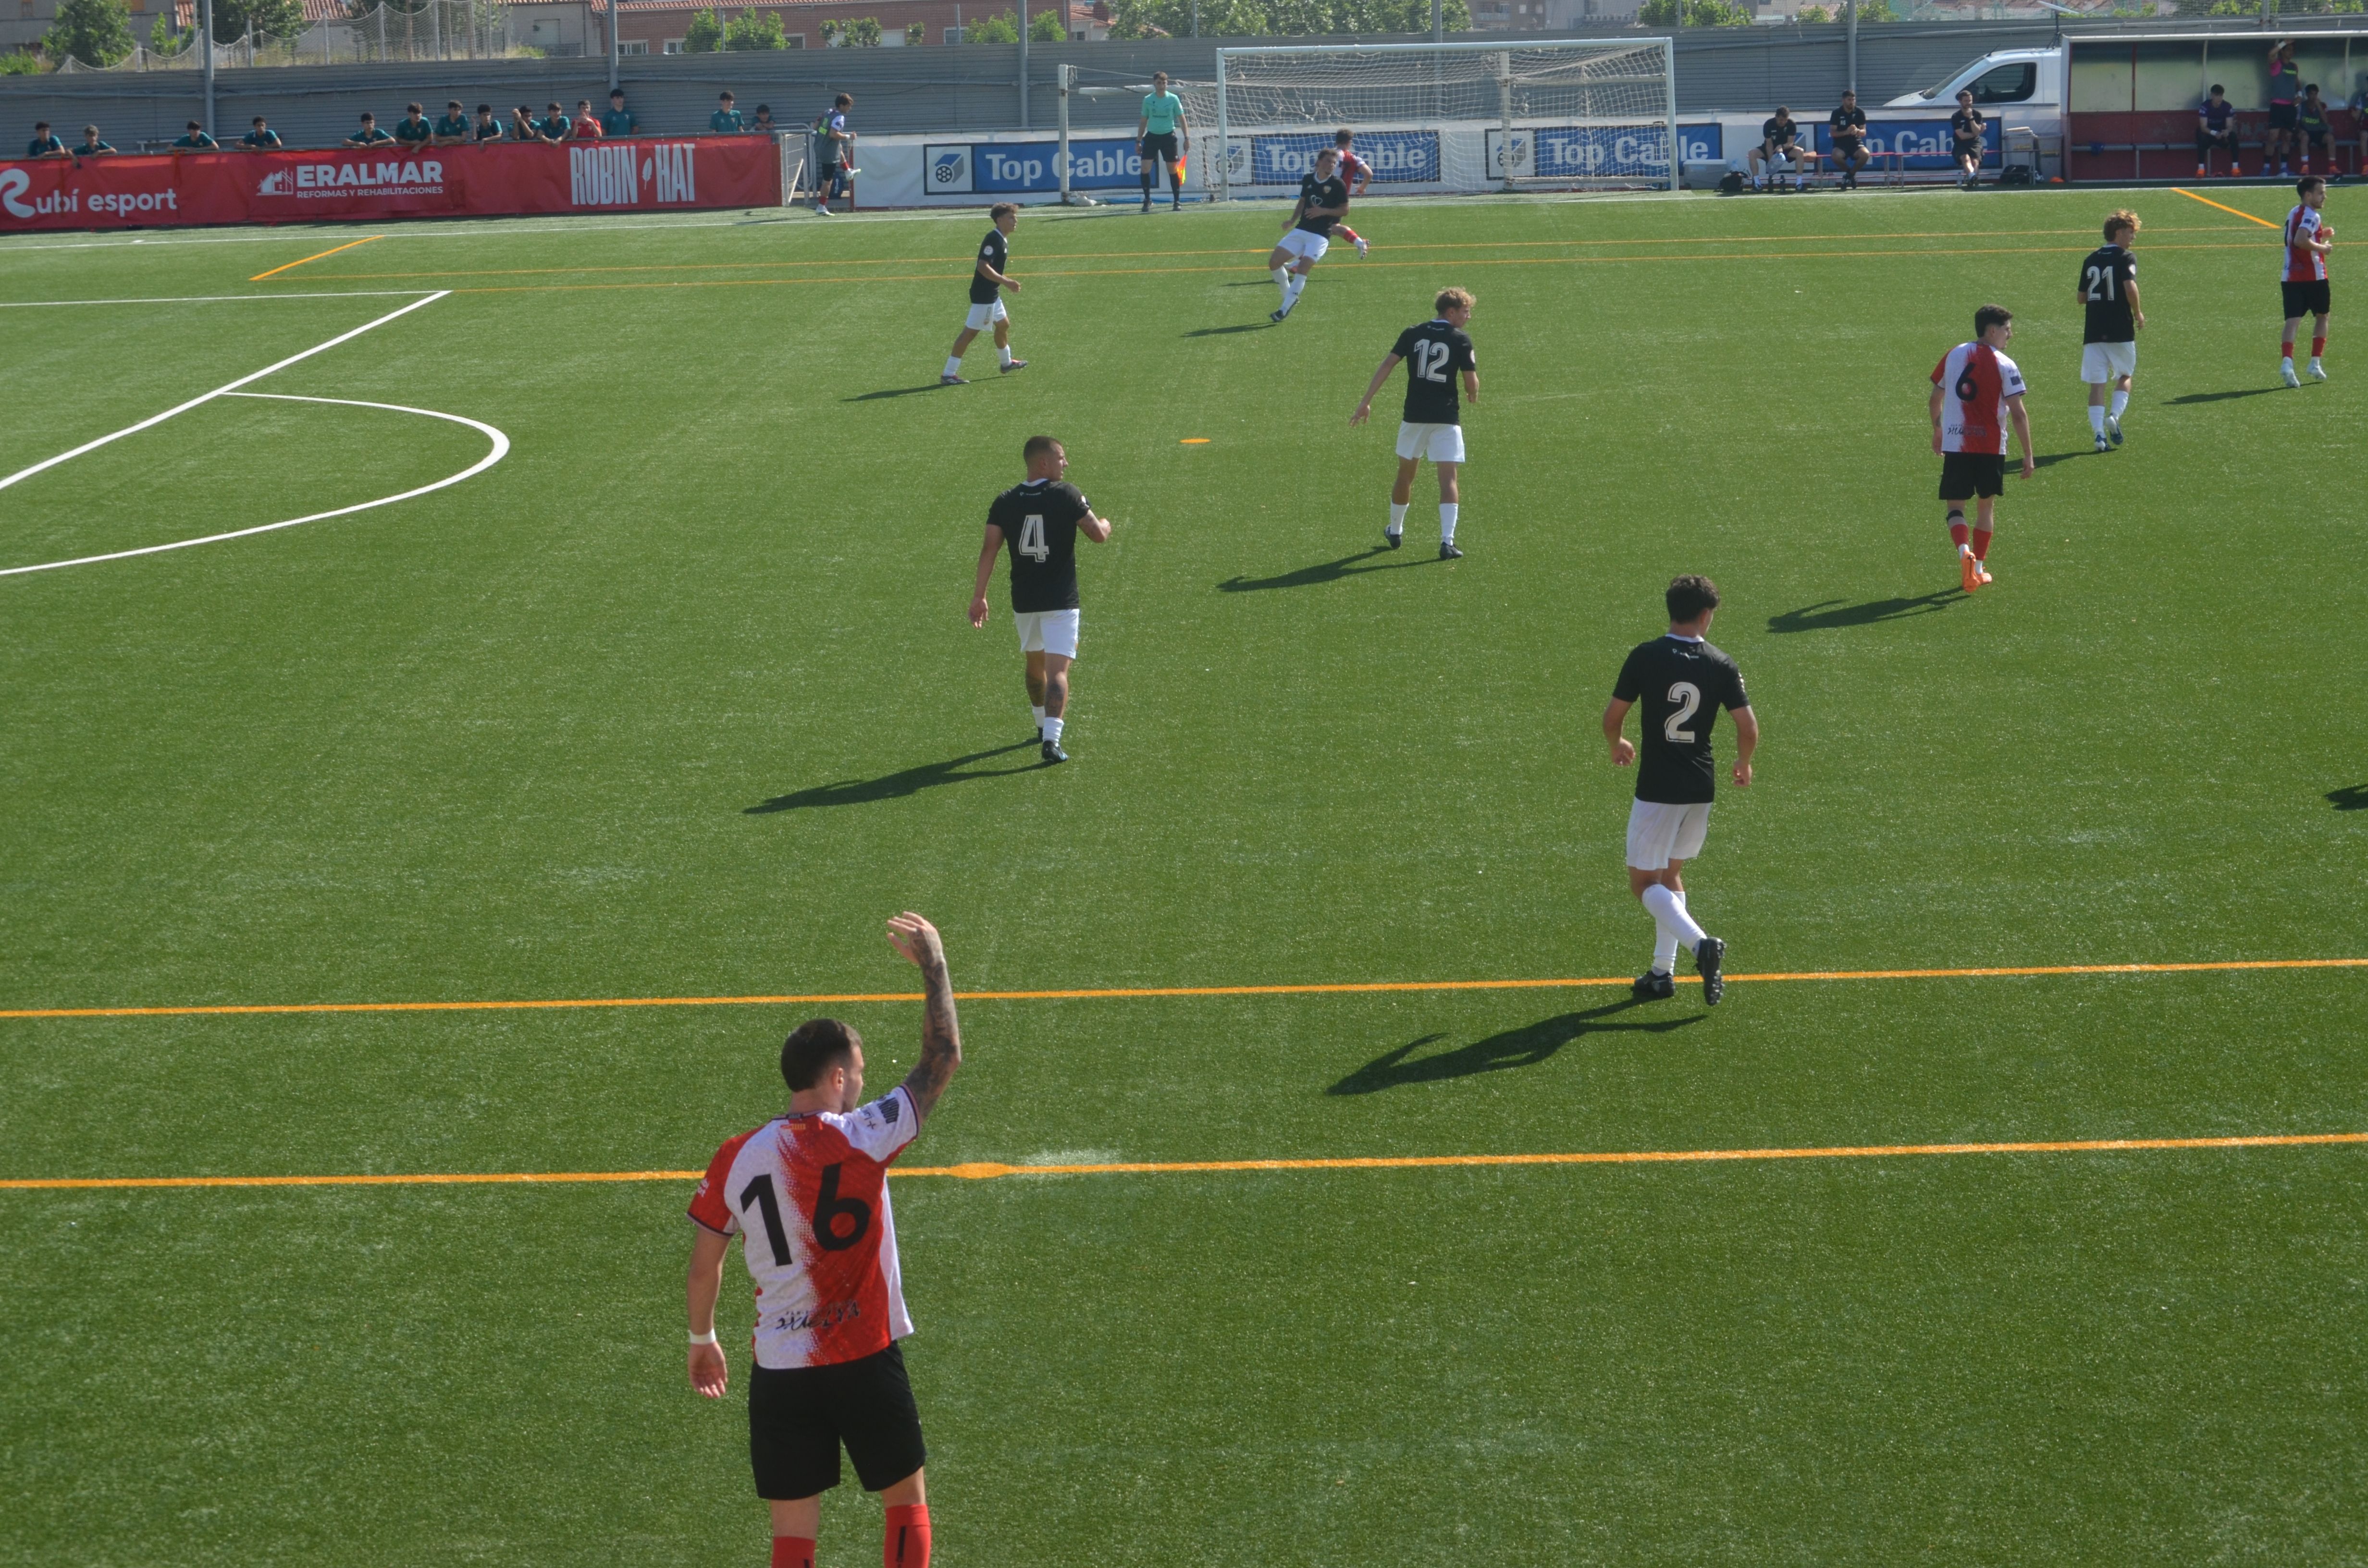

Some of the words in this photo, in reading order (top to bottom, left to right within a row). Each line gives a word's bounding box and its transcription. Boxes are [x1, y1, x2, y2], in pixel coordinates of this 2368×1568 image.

[296, 161, 444, 188] ERALMAR
[569, 146, 638, 206] ROBIN
[654, 143, 695, 202] HAT
[986, 153, 1042, 186] Top
[1052, 149, 1142, 178] Cable
[1351, 142, 1427, 170] able
[1548, 137, 1605, 171] Top
[0, 168, 79, 218] Rubí
[87, 188, 177, 218] esport
[296, 189, 347, 198] REFORMAS
[350, 189, 356, 197] Y
[357, 186, 443, 196] REHABILITACIONES
[2087, 265, 2114, 302] 21
[1414, 338, 1450, 383] 12
[1955, 361, 1978, 402] 6
[1018, 514, 1049, 563] 4
[1664, 681, 1701, 744] 2
[740, 1161, 872, 1267] 16
